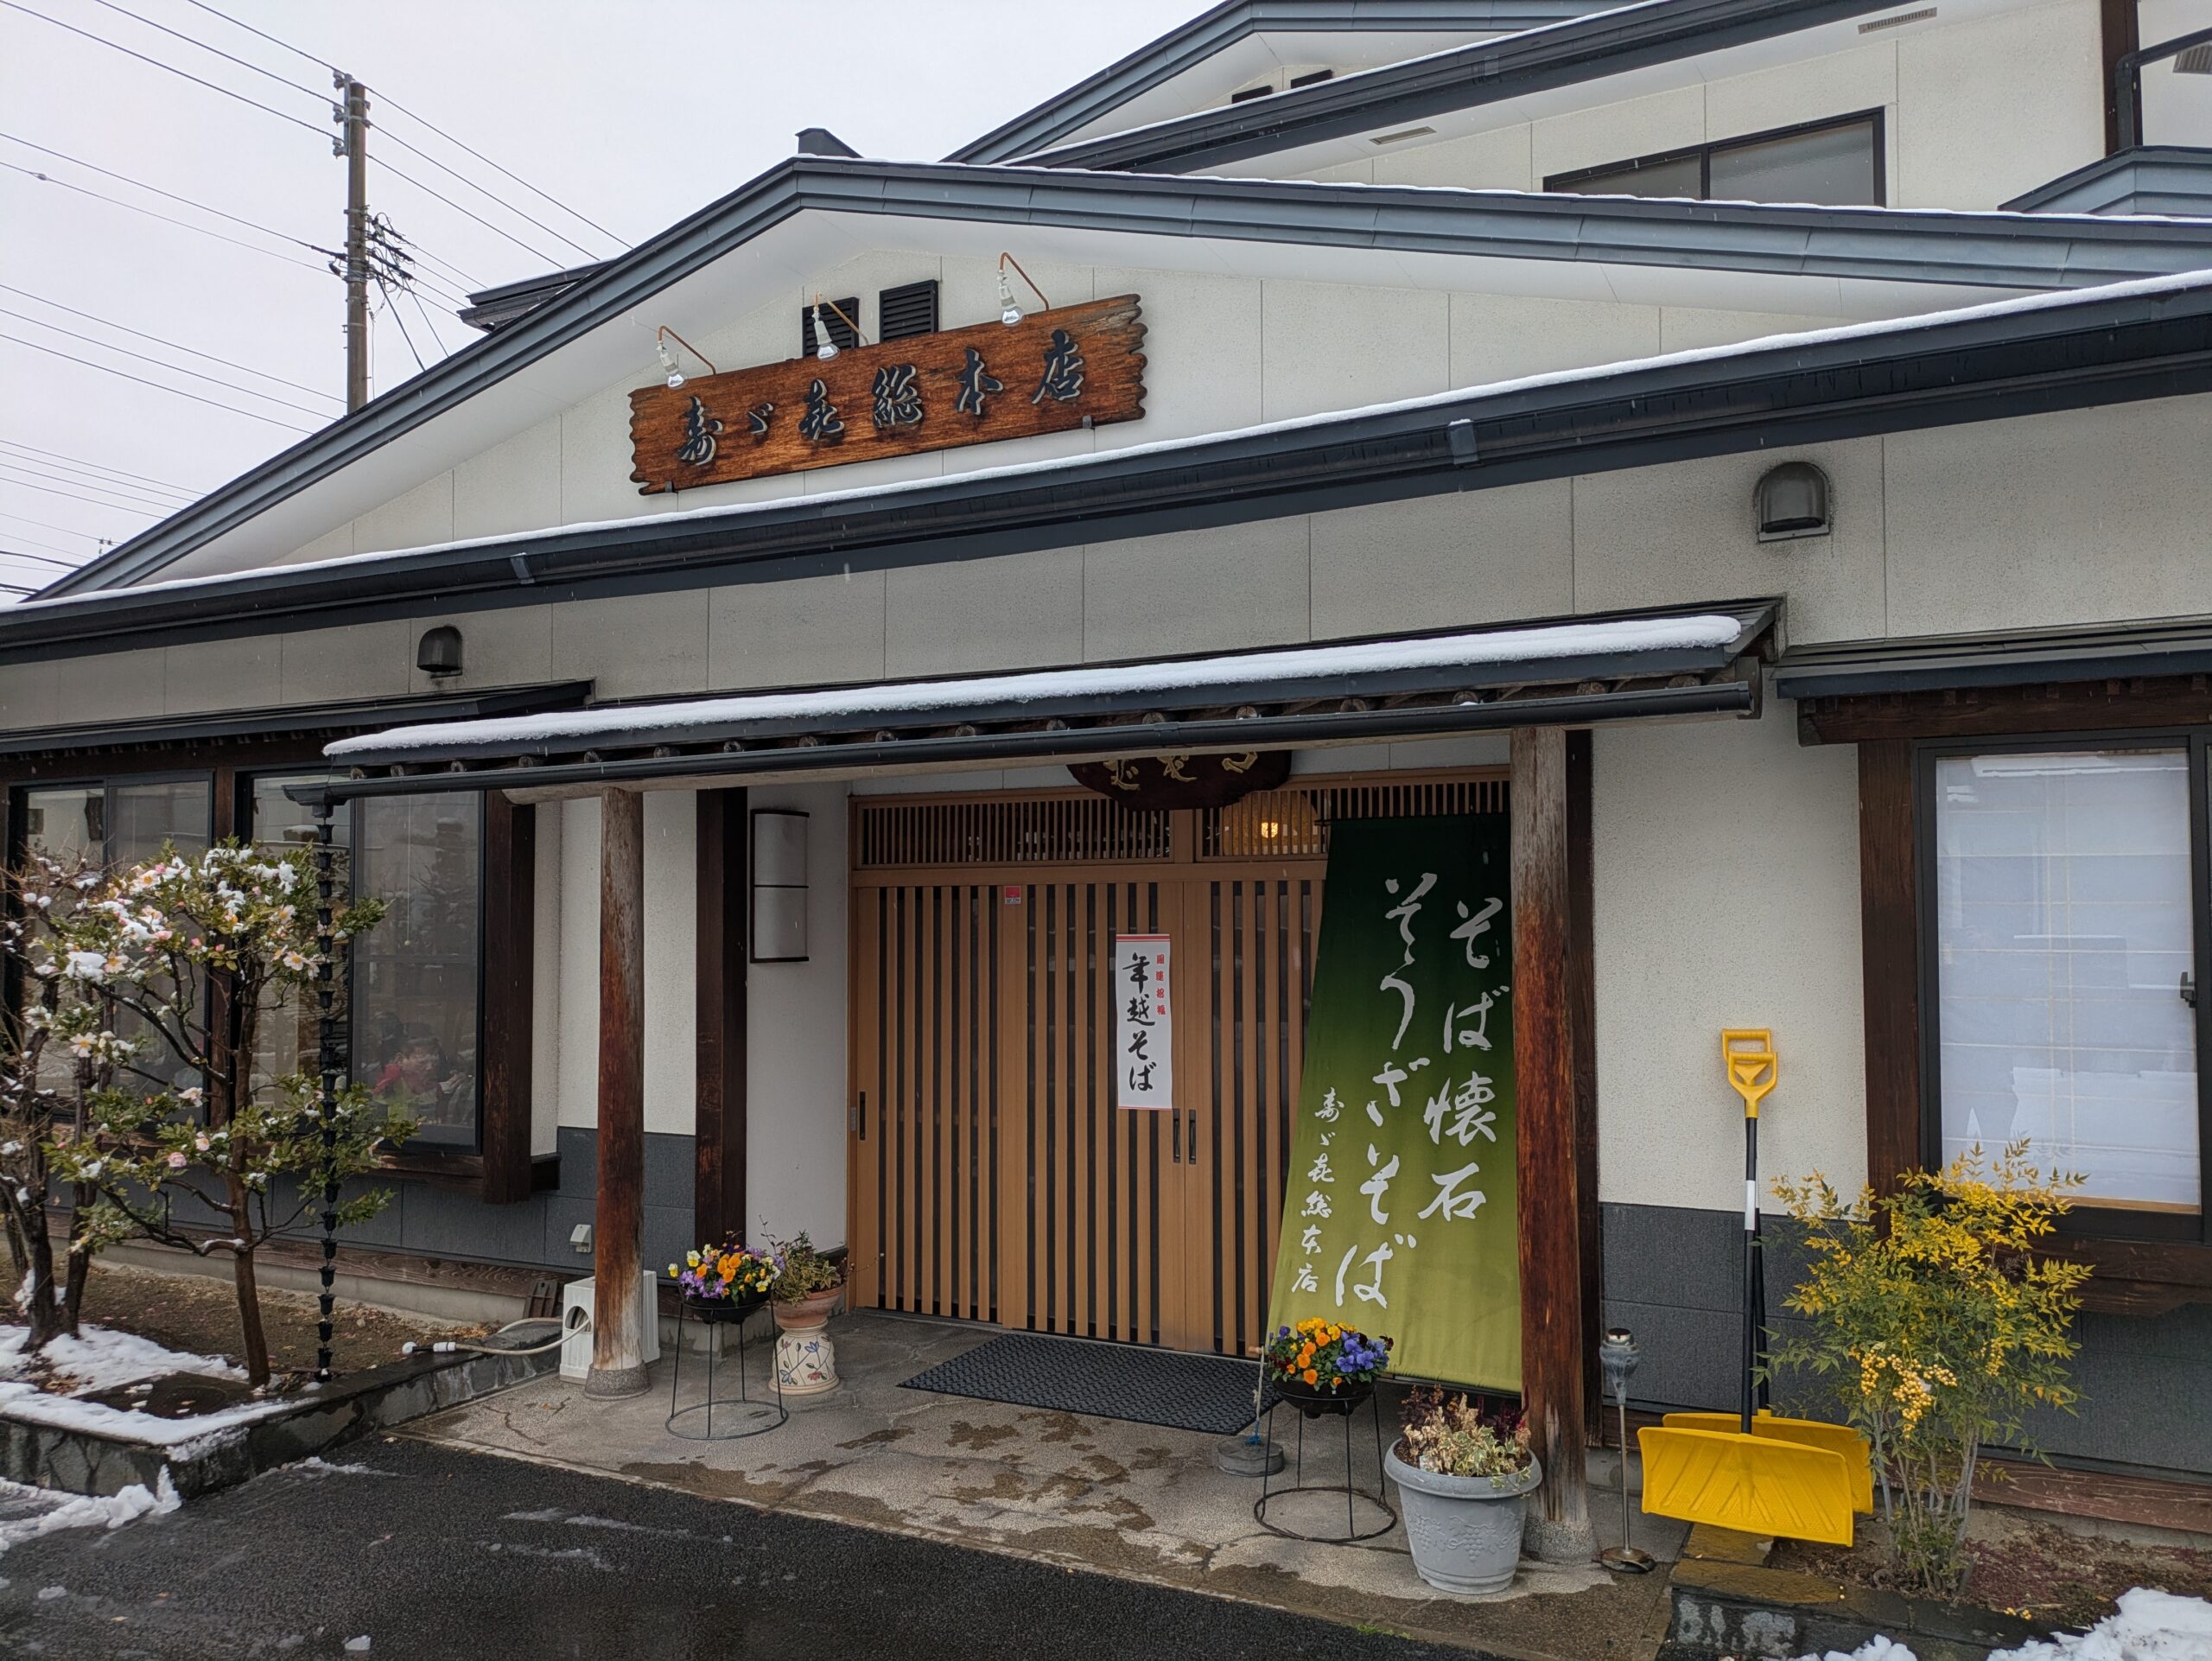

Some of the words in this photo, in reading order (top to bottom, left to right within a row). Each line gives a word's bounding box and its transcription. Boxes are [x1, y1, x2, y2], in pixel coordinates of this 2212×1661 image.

[1122, 952, 1157, 1091] 年越そば
[1417, 897, 1510, 1222] そば懐石
